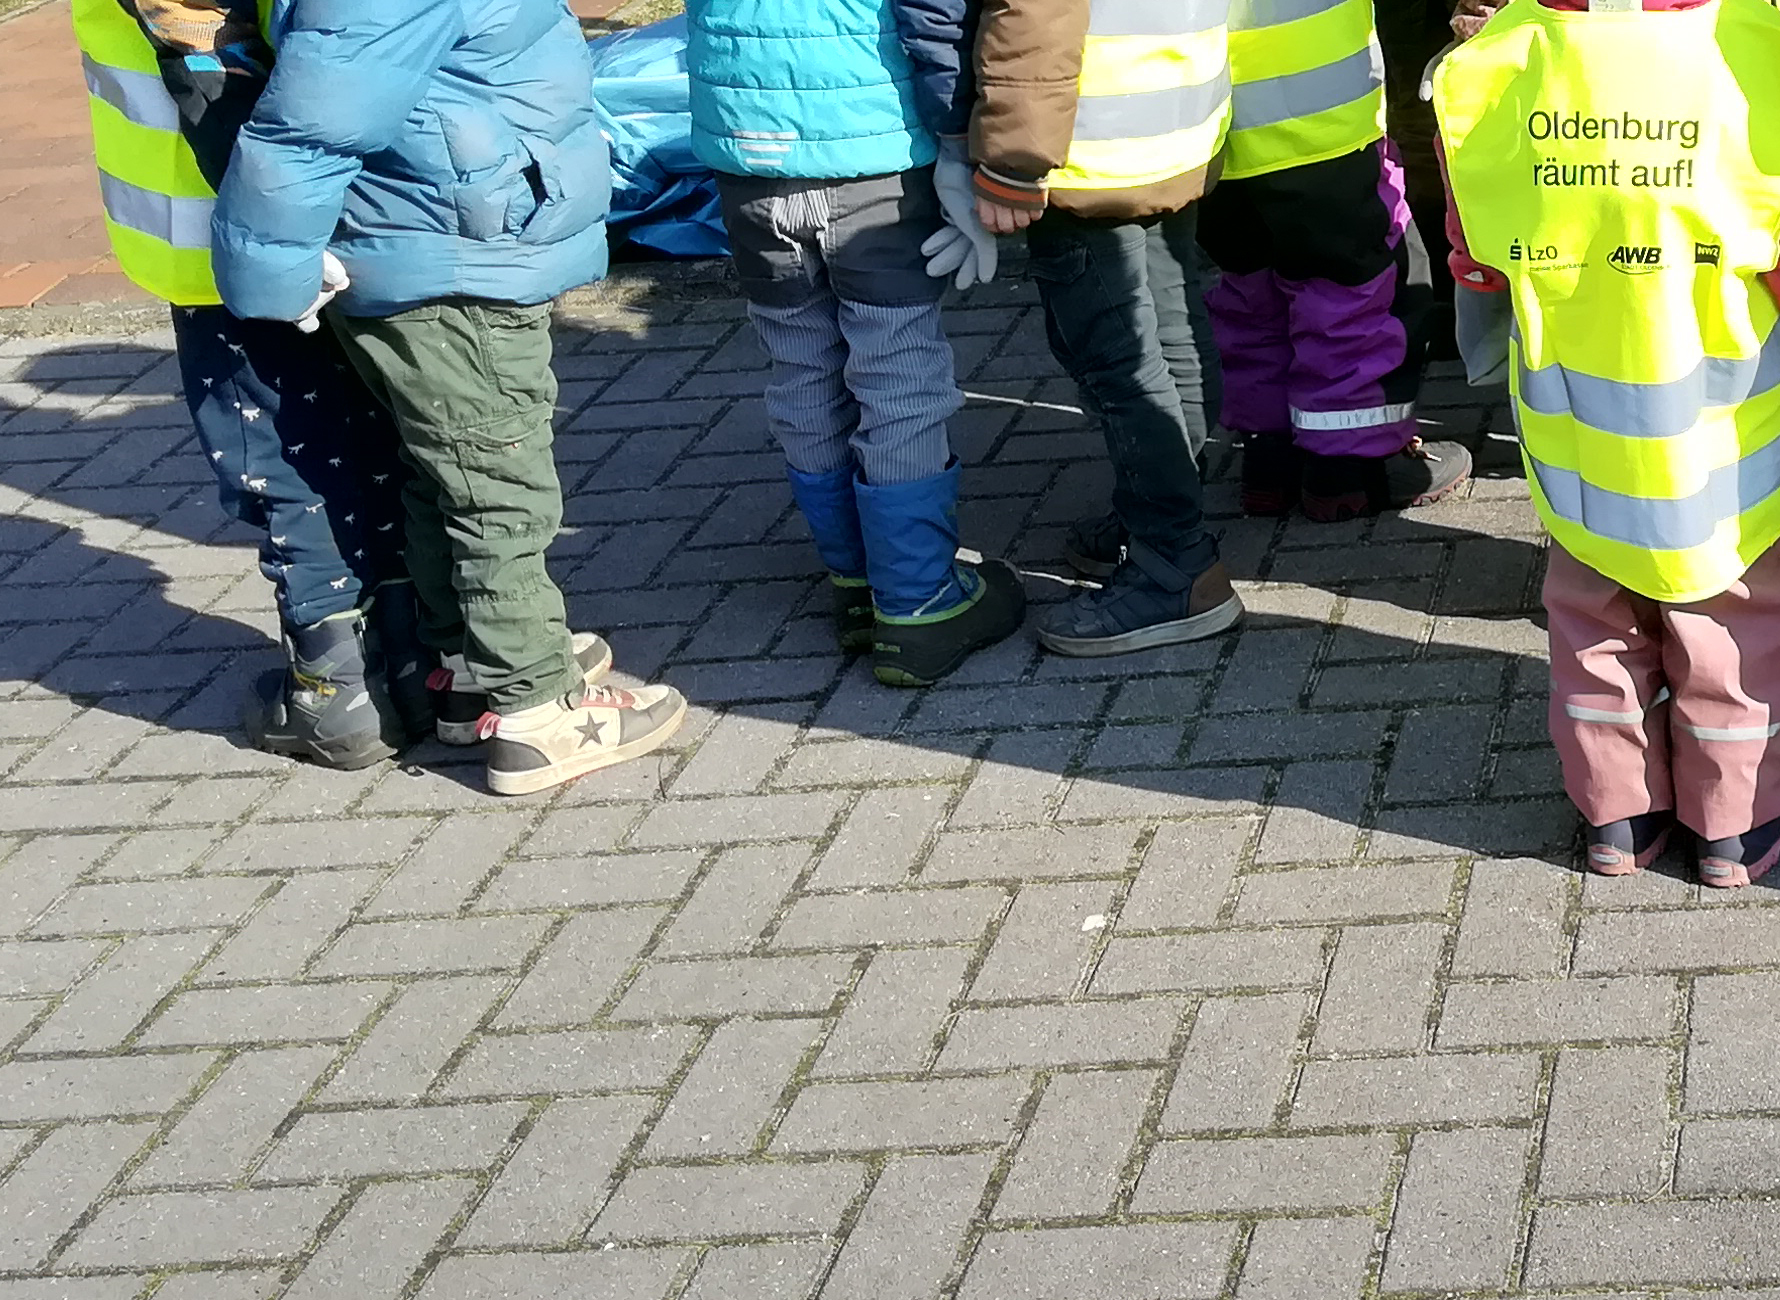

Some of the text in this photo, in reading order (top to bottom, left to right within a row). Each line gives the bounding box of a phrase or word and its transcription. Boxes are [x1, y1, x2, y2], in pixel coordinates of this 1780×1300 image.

[1528, 111, 1700, 149] Oldenburg
[1533, 156, 1693, 187] räumt auf!
[1527, 245, 1558, 262] LzO
[1610, 246, 1662, 264] AWB
